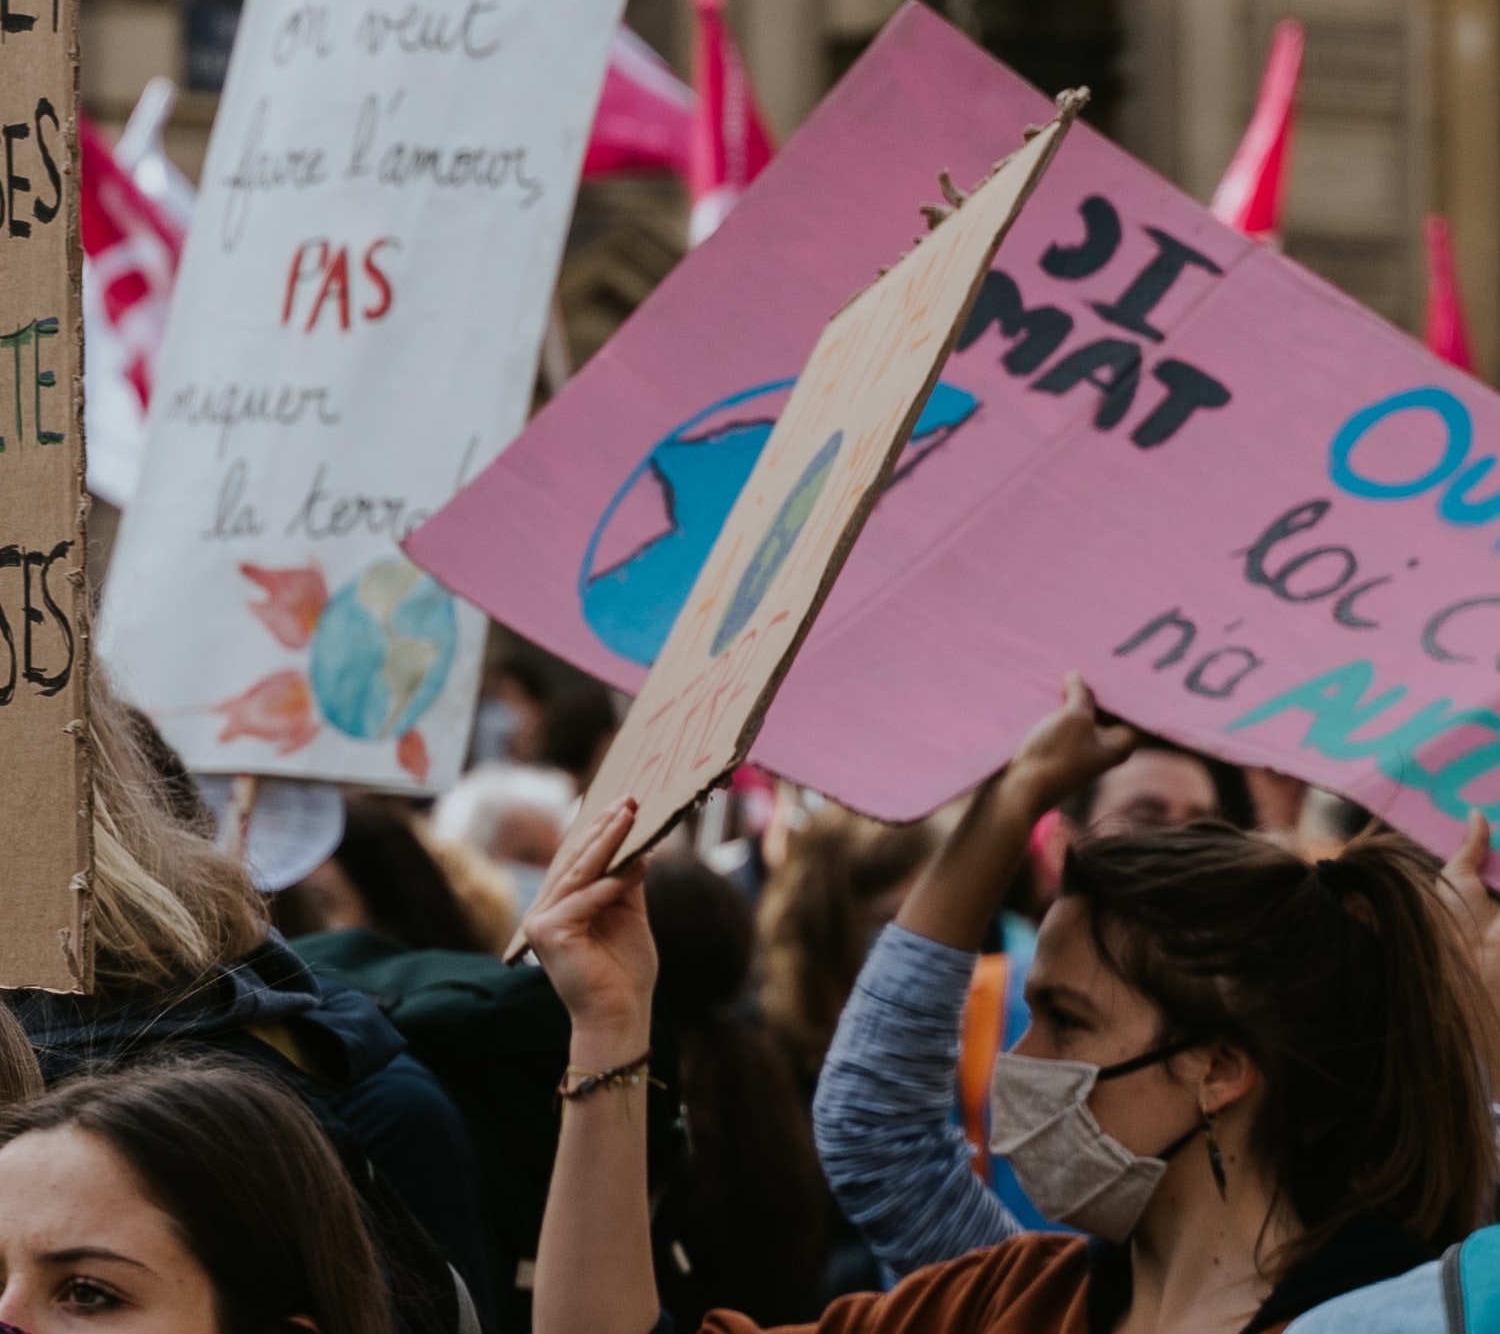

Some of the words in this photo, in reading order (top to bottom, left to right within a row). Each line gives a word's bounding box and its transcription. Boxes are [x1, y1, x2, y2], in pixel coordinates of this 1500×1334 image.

[221, 97, 328, 253] faire
[282, 237, 402, 335] PAS
[955, 271, 1233, 451] MAT
[202, 460, 268, 543] la
[1230, 497, 1420, 630] loi
